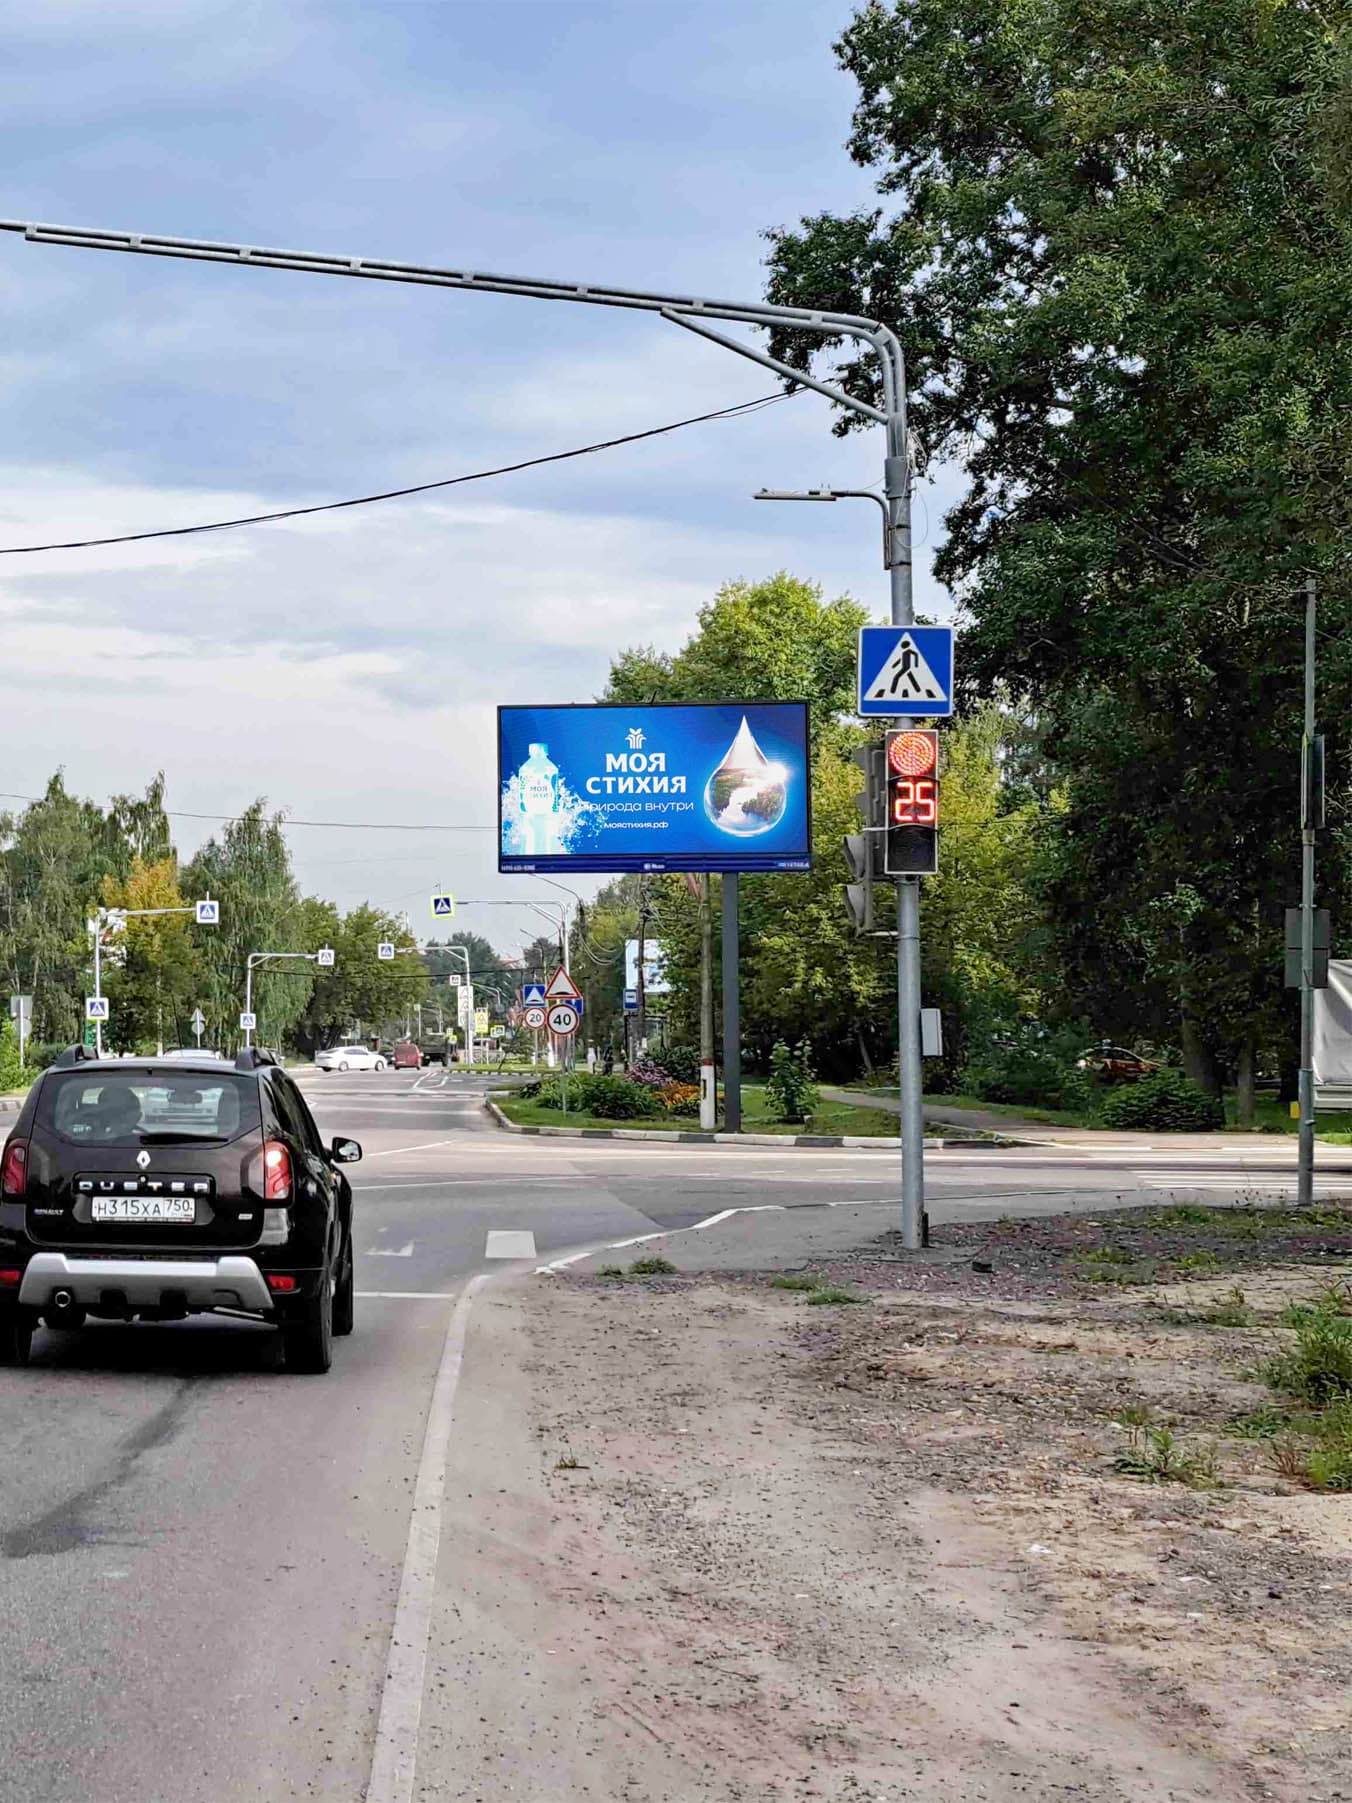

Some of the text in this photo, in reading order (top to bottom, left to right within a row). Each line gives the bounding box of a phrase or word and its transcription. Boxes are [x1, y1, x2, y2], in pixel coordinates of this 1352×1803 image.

[605, 752, 666, 773] МОЯ
[585, 775, 687, 795] СТИХИЯ
[580, 801, 695, 813] рирода внутри
[894, 781, 935, 821] 25
[529, 1013, 542, 1023] 20
[552, 1012, 572, 1026] 40
[78, 1180, 209, 1193] DUSTER
[166, 1199, 190, 1212] 750
